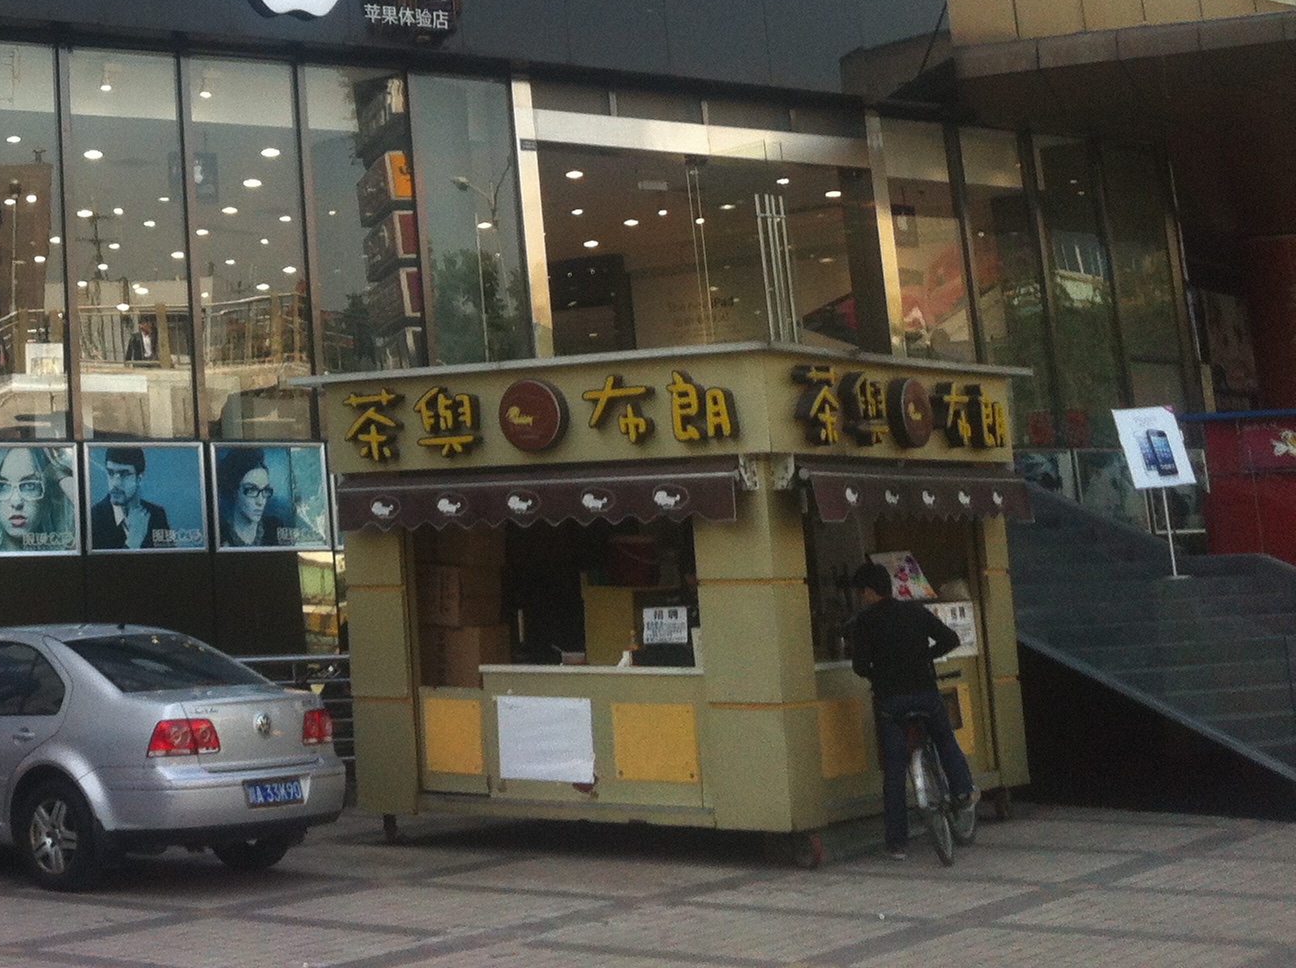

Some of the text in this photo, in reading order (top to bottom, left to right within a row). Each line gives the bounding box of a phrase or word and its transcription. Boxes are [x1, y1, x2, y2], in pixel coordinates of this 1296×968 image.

[363, 3, 449, 29] 苹果体验店
